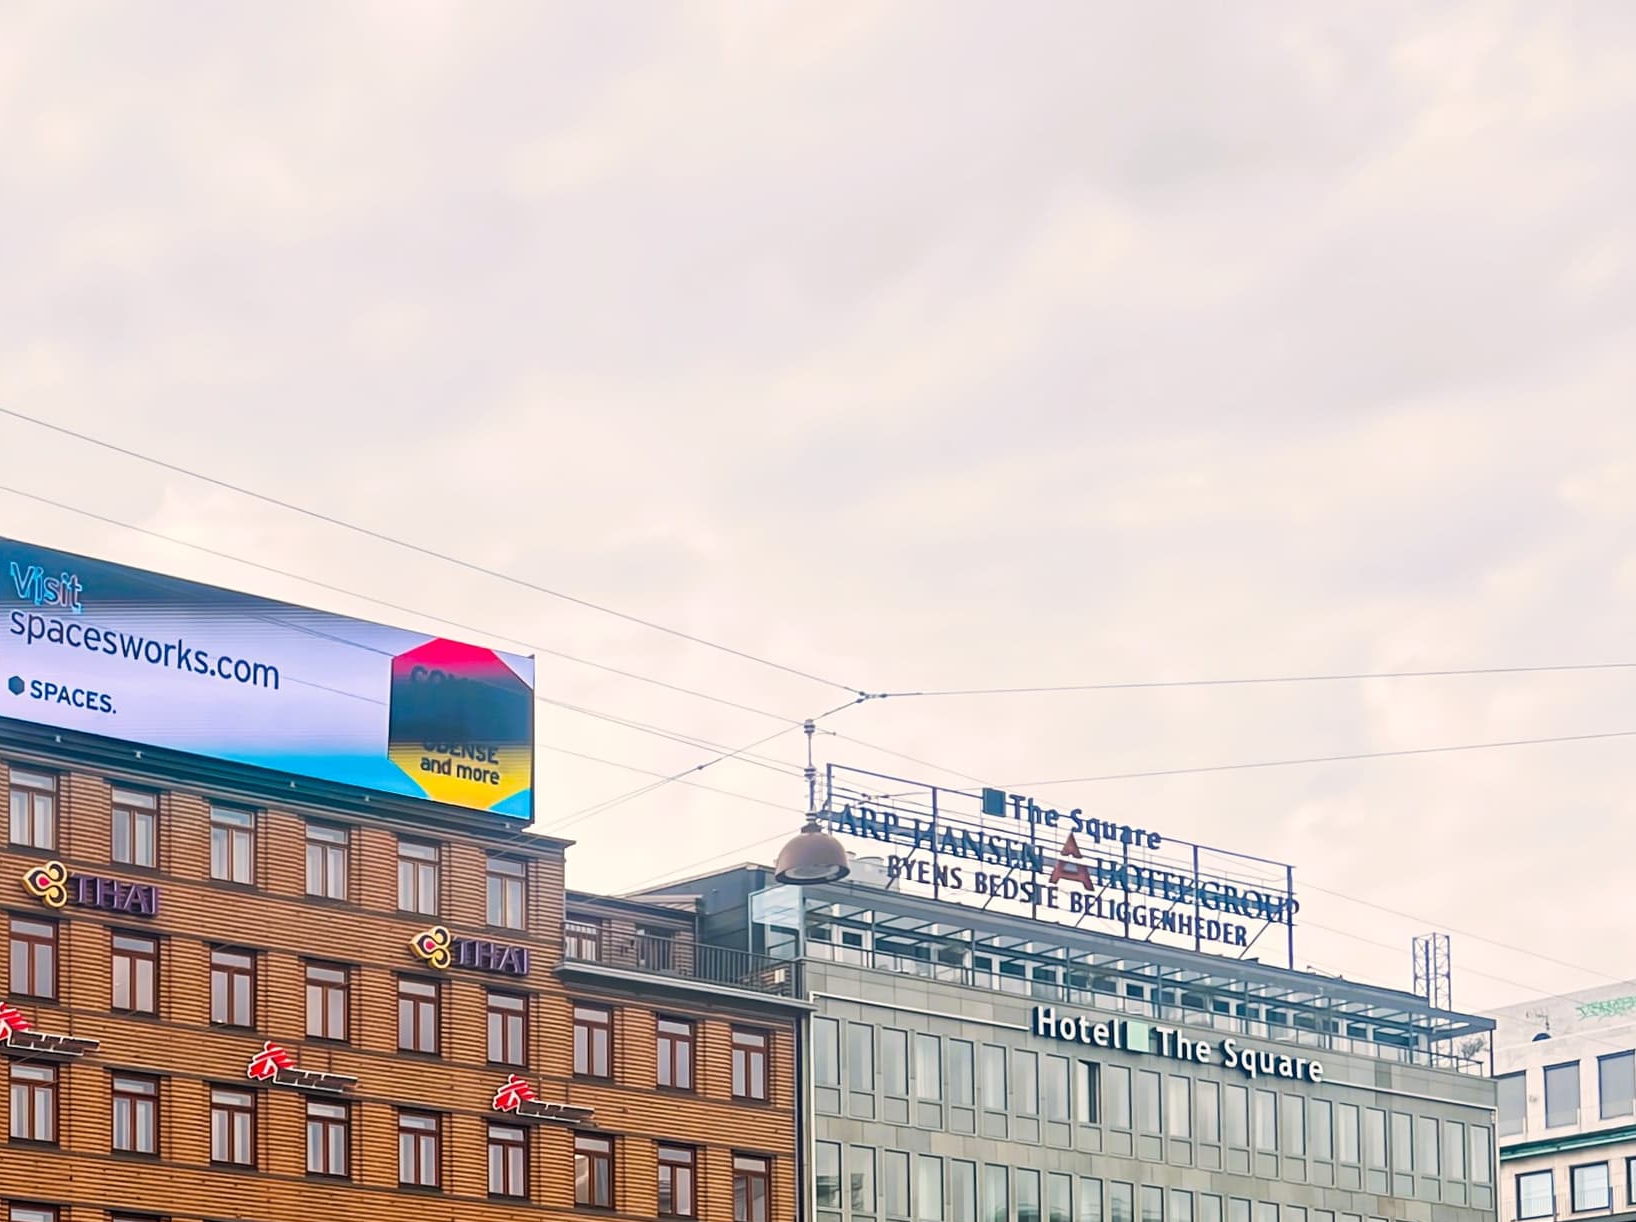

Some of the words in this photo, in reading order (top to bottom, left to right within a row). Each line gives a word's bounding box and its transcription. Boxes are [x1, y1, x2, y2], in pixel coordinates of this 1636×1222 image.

[10, 561, 83, 614] Visit
[9, 609, 280, 690] spacesworks.com
[420, 756, 452, 776] and
[456, 764, 500, 785] more
[836, 803, 898, 842] ARP
[1009, 793, 1059, 828] The
[1069, 808, 1162, 850] Square
[70, 871, 160, 916] THAI
[886, 854, 964, 890] BYENS
[974, 871, 1059, 910] BEDSTE
[1069, 881, 1248, 947] BELIGGENHEDER
[453, 936, 530, 976] THAI
[1033, 1006, 1121, 1049] Hotel
[1155, 1024, 1211, 1065] The
[1223, 1037, 1324, 1084] Square
